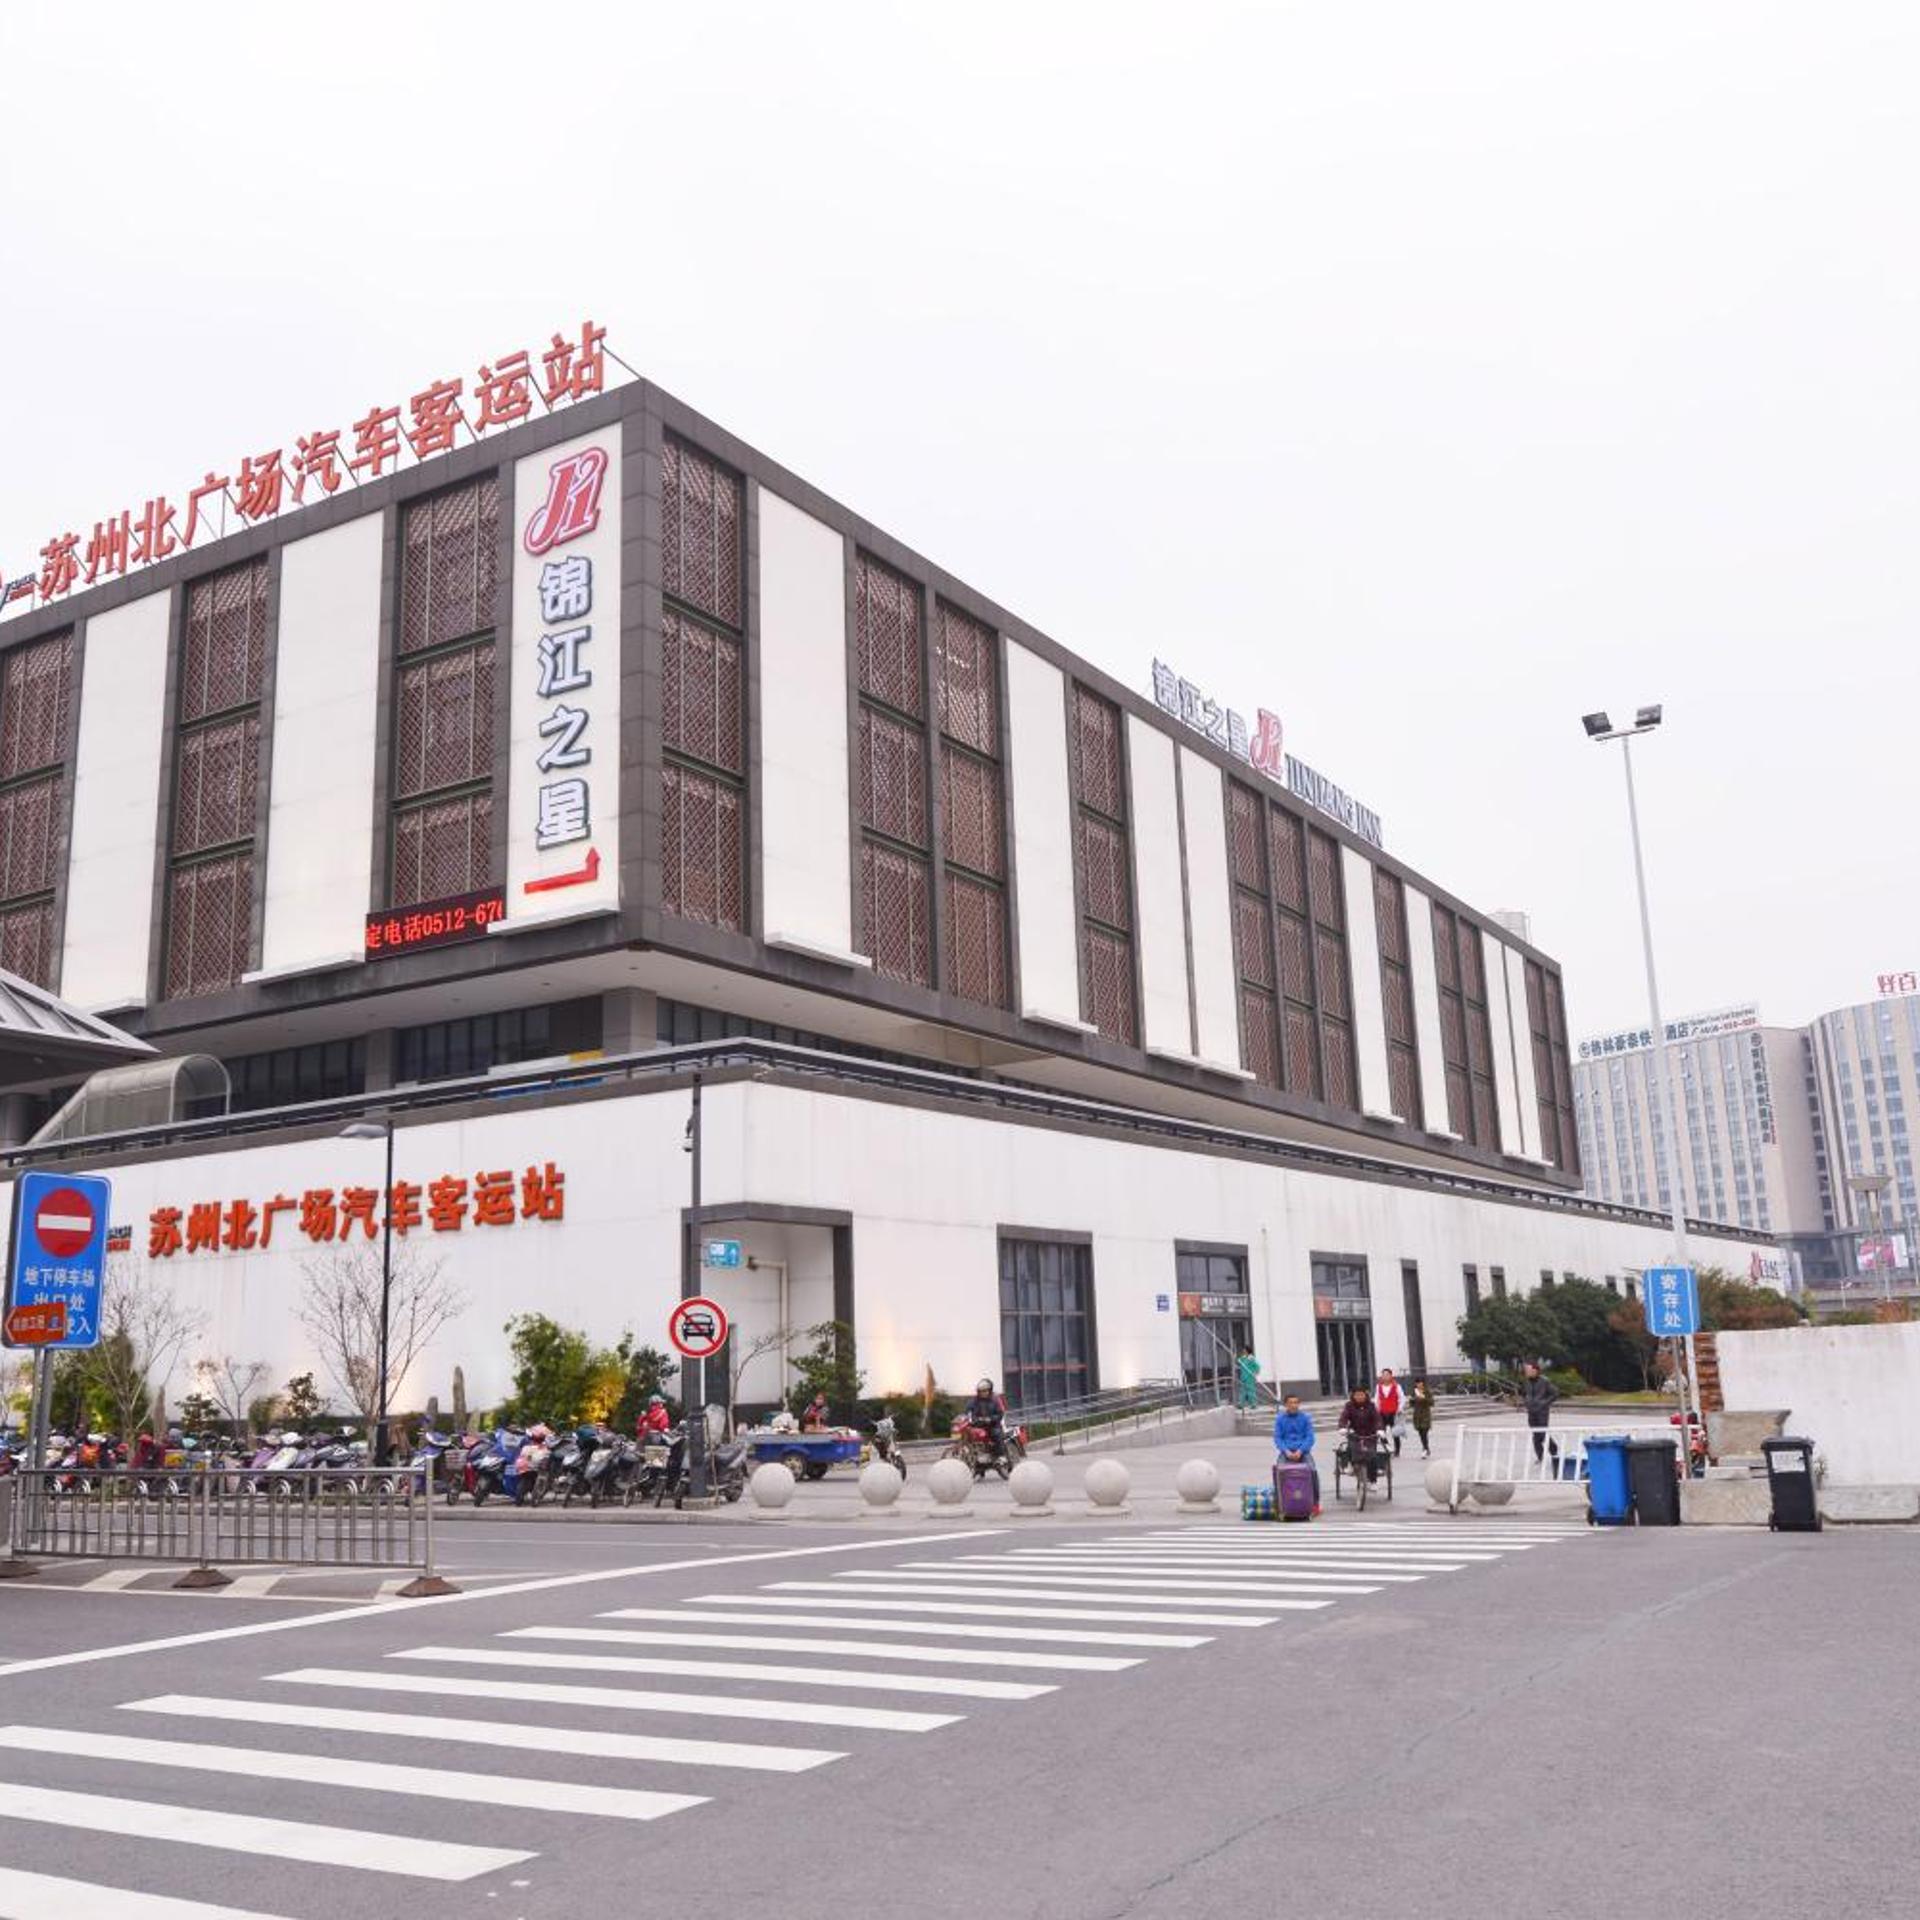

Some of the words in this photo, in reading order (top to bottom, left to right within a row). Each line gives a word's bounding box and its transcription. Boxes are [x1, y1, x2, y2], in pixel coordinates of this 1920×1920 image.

[39, 321, 606, 600] 苏州北广场汽车客运站
[537, 556, 593, 851] 锦江之星
[1152, 656, 1249, 767] 锦江之星
[148, 1162, 566, 1258] 苏州北广场汽车客运站
[23, 1266, 96, 1288] 地下停车场
[1660, 1274, 1683, 1328] 寄存处
